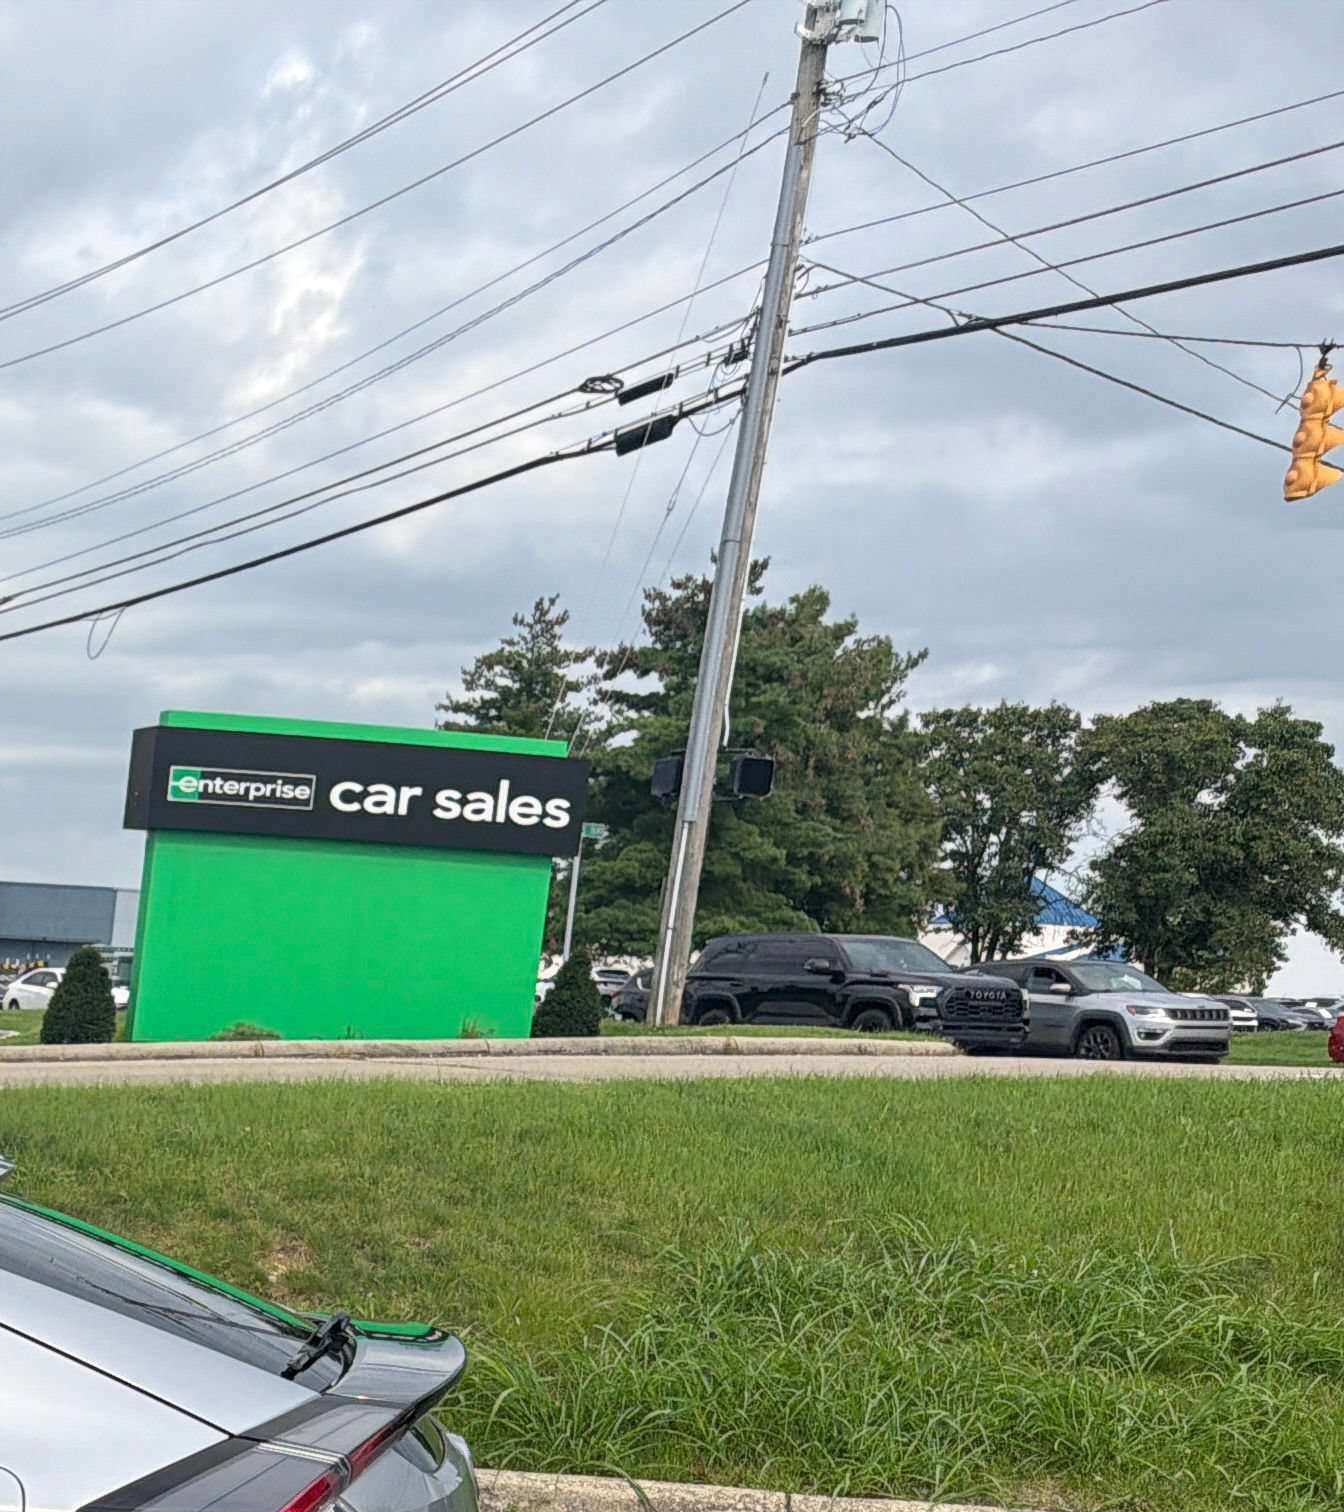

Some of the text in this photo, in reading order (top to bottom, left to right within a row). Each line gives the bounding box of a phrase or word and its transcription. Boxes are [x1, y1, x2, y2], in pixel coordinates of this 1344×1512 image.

[178, 774, 571, 828] enterprise car sales
[970, 990, 1007, 1000] TOYOTA
